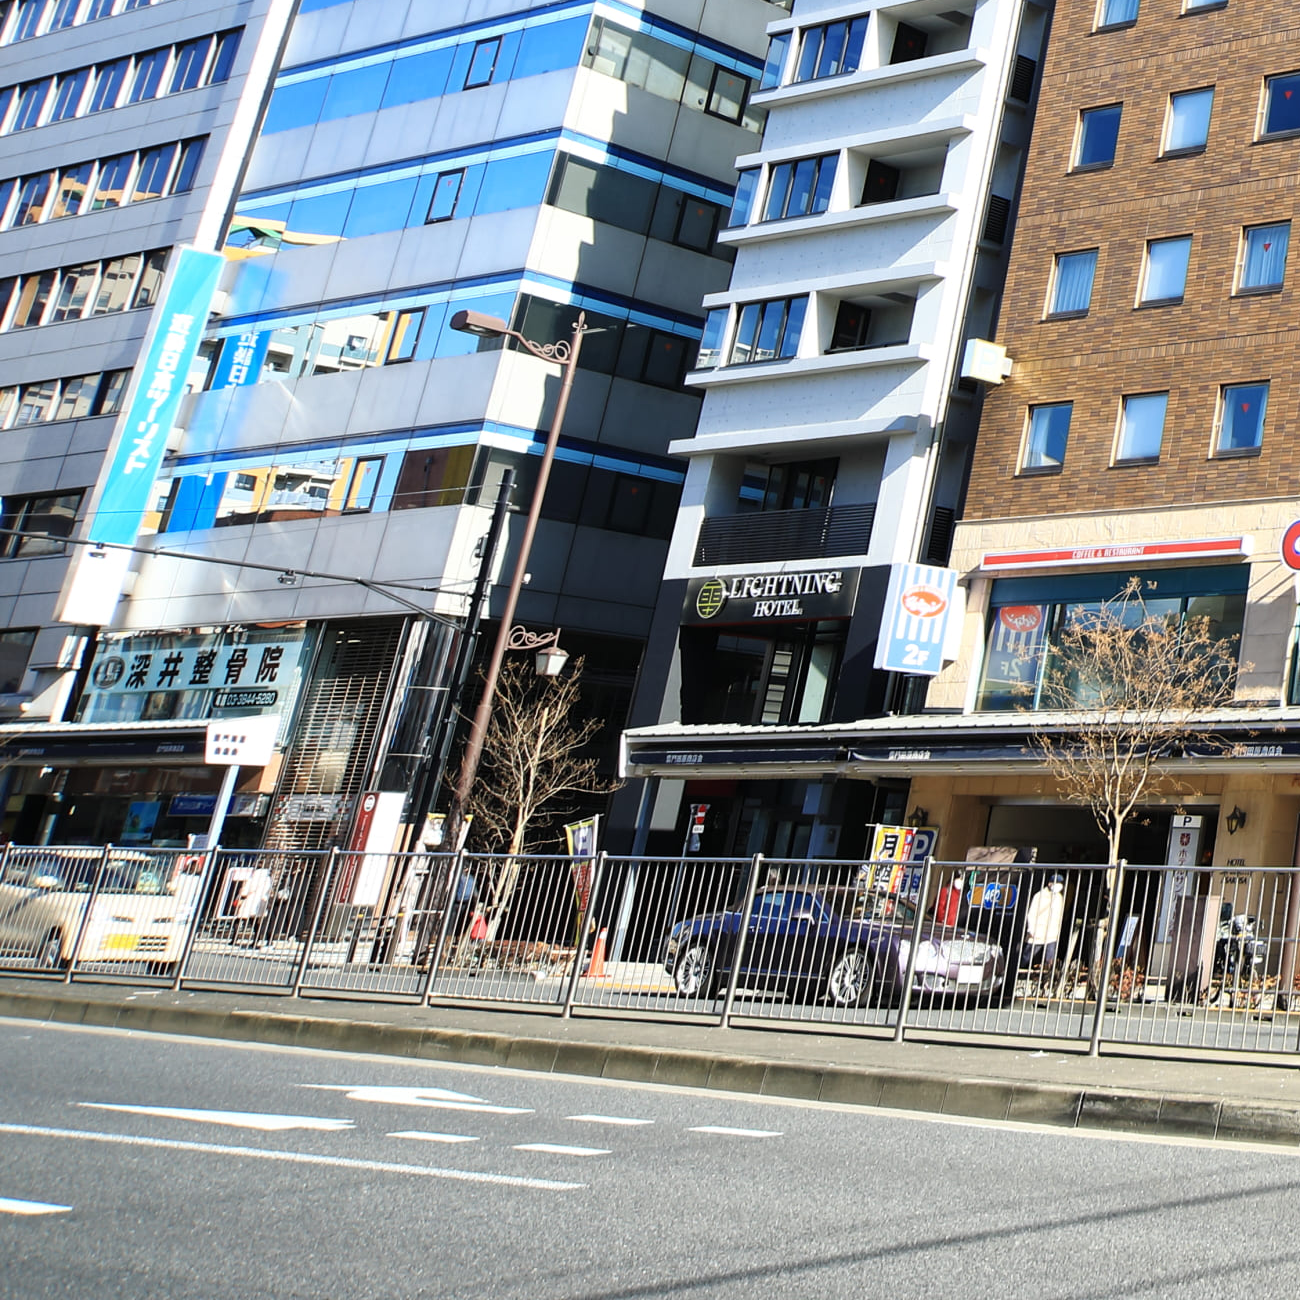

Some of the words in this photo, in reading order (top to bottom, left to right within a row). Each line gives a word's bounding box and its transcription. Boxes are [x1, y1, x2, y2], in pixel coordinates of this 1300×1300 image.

[1071, 549, 1095, 560] COFFEE
[1103, 546, 1145, 557] RESTAURANT
[727, 571, 843, 600] LIGHTNING
[752, 599, 803, 618] HOTEL
[902, 643, 931, 666] 2F
[125, 645, 285, 689] 深井整骨院
[1182, 816, 1192, 827] P
[908, 833, 929, 863] P
